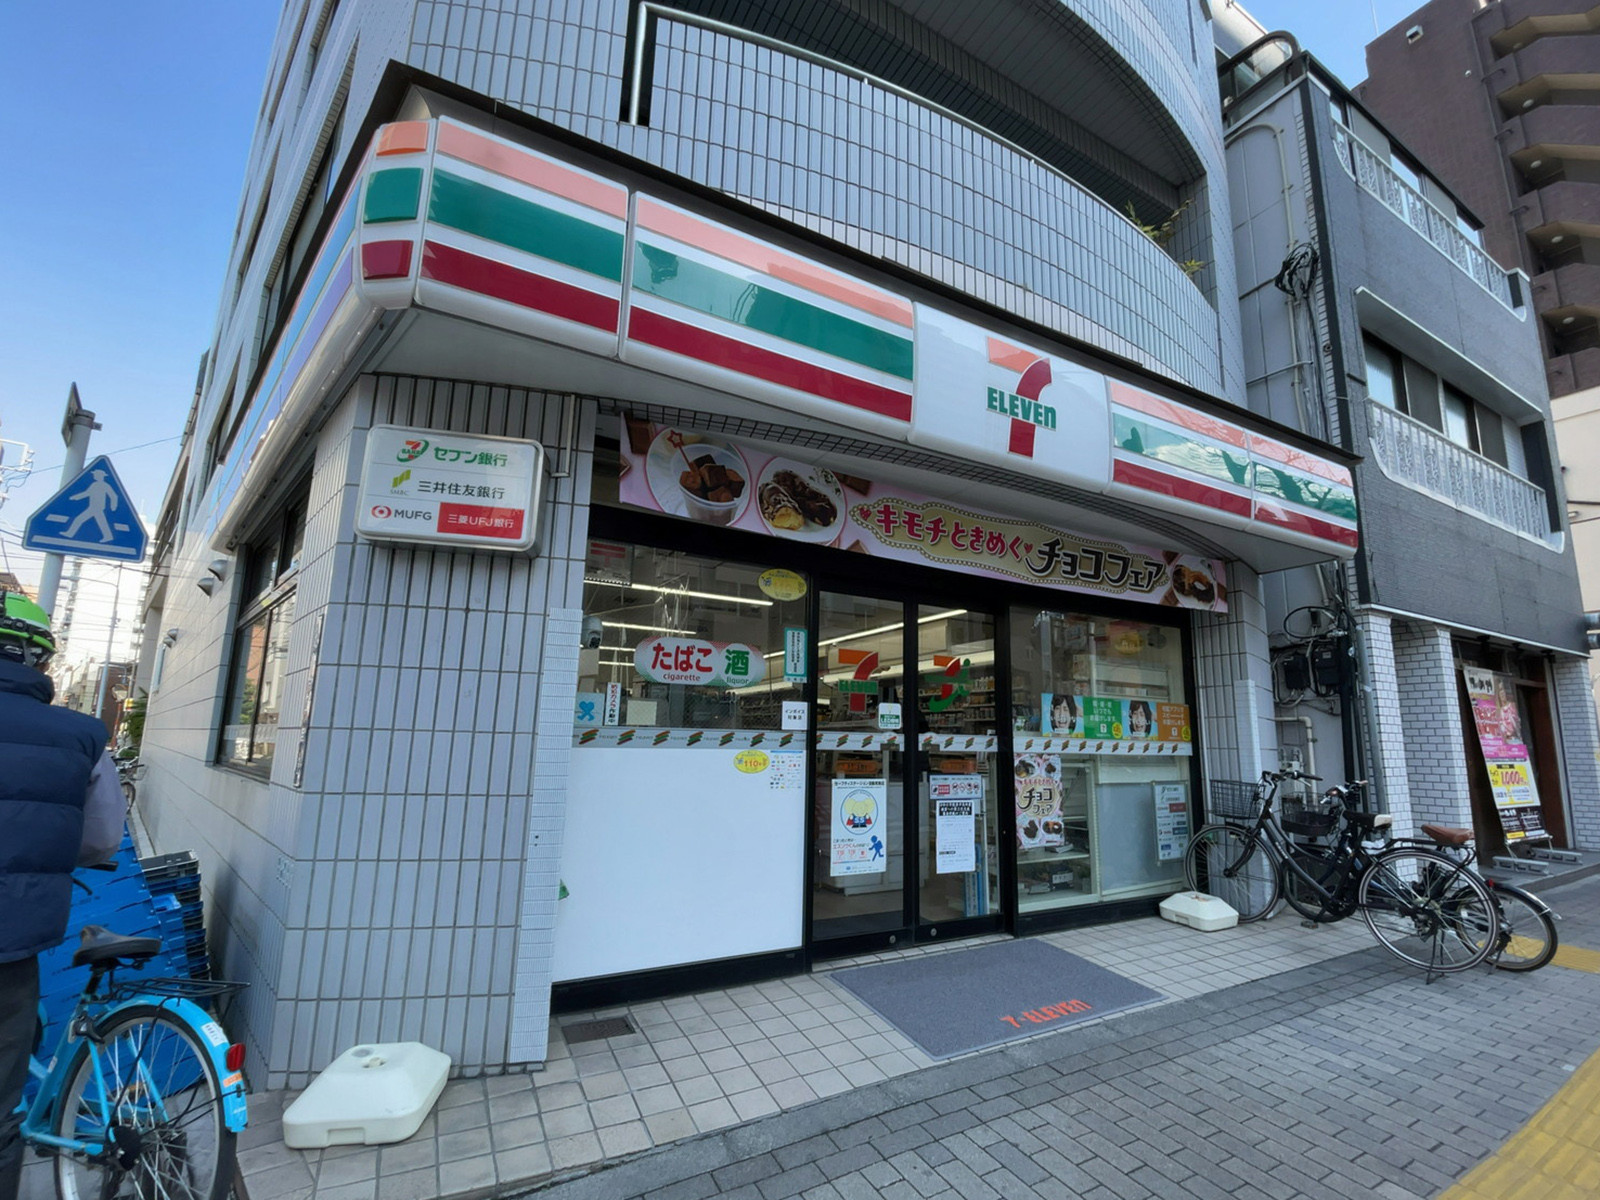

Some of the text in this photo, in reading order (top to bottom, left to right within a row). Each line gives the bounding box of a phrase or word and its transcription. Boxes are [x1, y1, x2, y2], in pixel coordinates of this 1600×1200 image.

[434, 447, 508, 467] セブン銀行
[417, 480, 505, 499] 三井住友銀行
[394, 509, 432, 521] MUFG
[447, 514, 514, 528] 三菱UFJ銀行
[876, 503, 1165, 588] キモチときめく チョコフェア
[652, 643, 713, 673] たばこ
[725, 649, 749, 676] 酒
[663, 673, 701, 683] cigarette
[726, 677, 750, 685] liquor
[1017, 787, 1053, 809] チョコ
[1033, 804, 1053, 814] フェア
